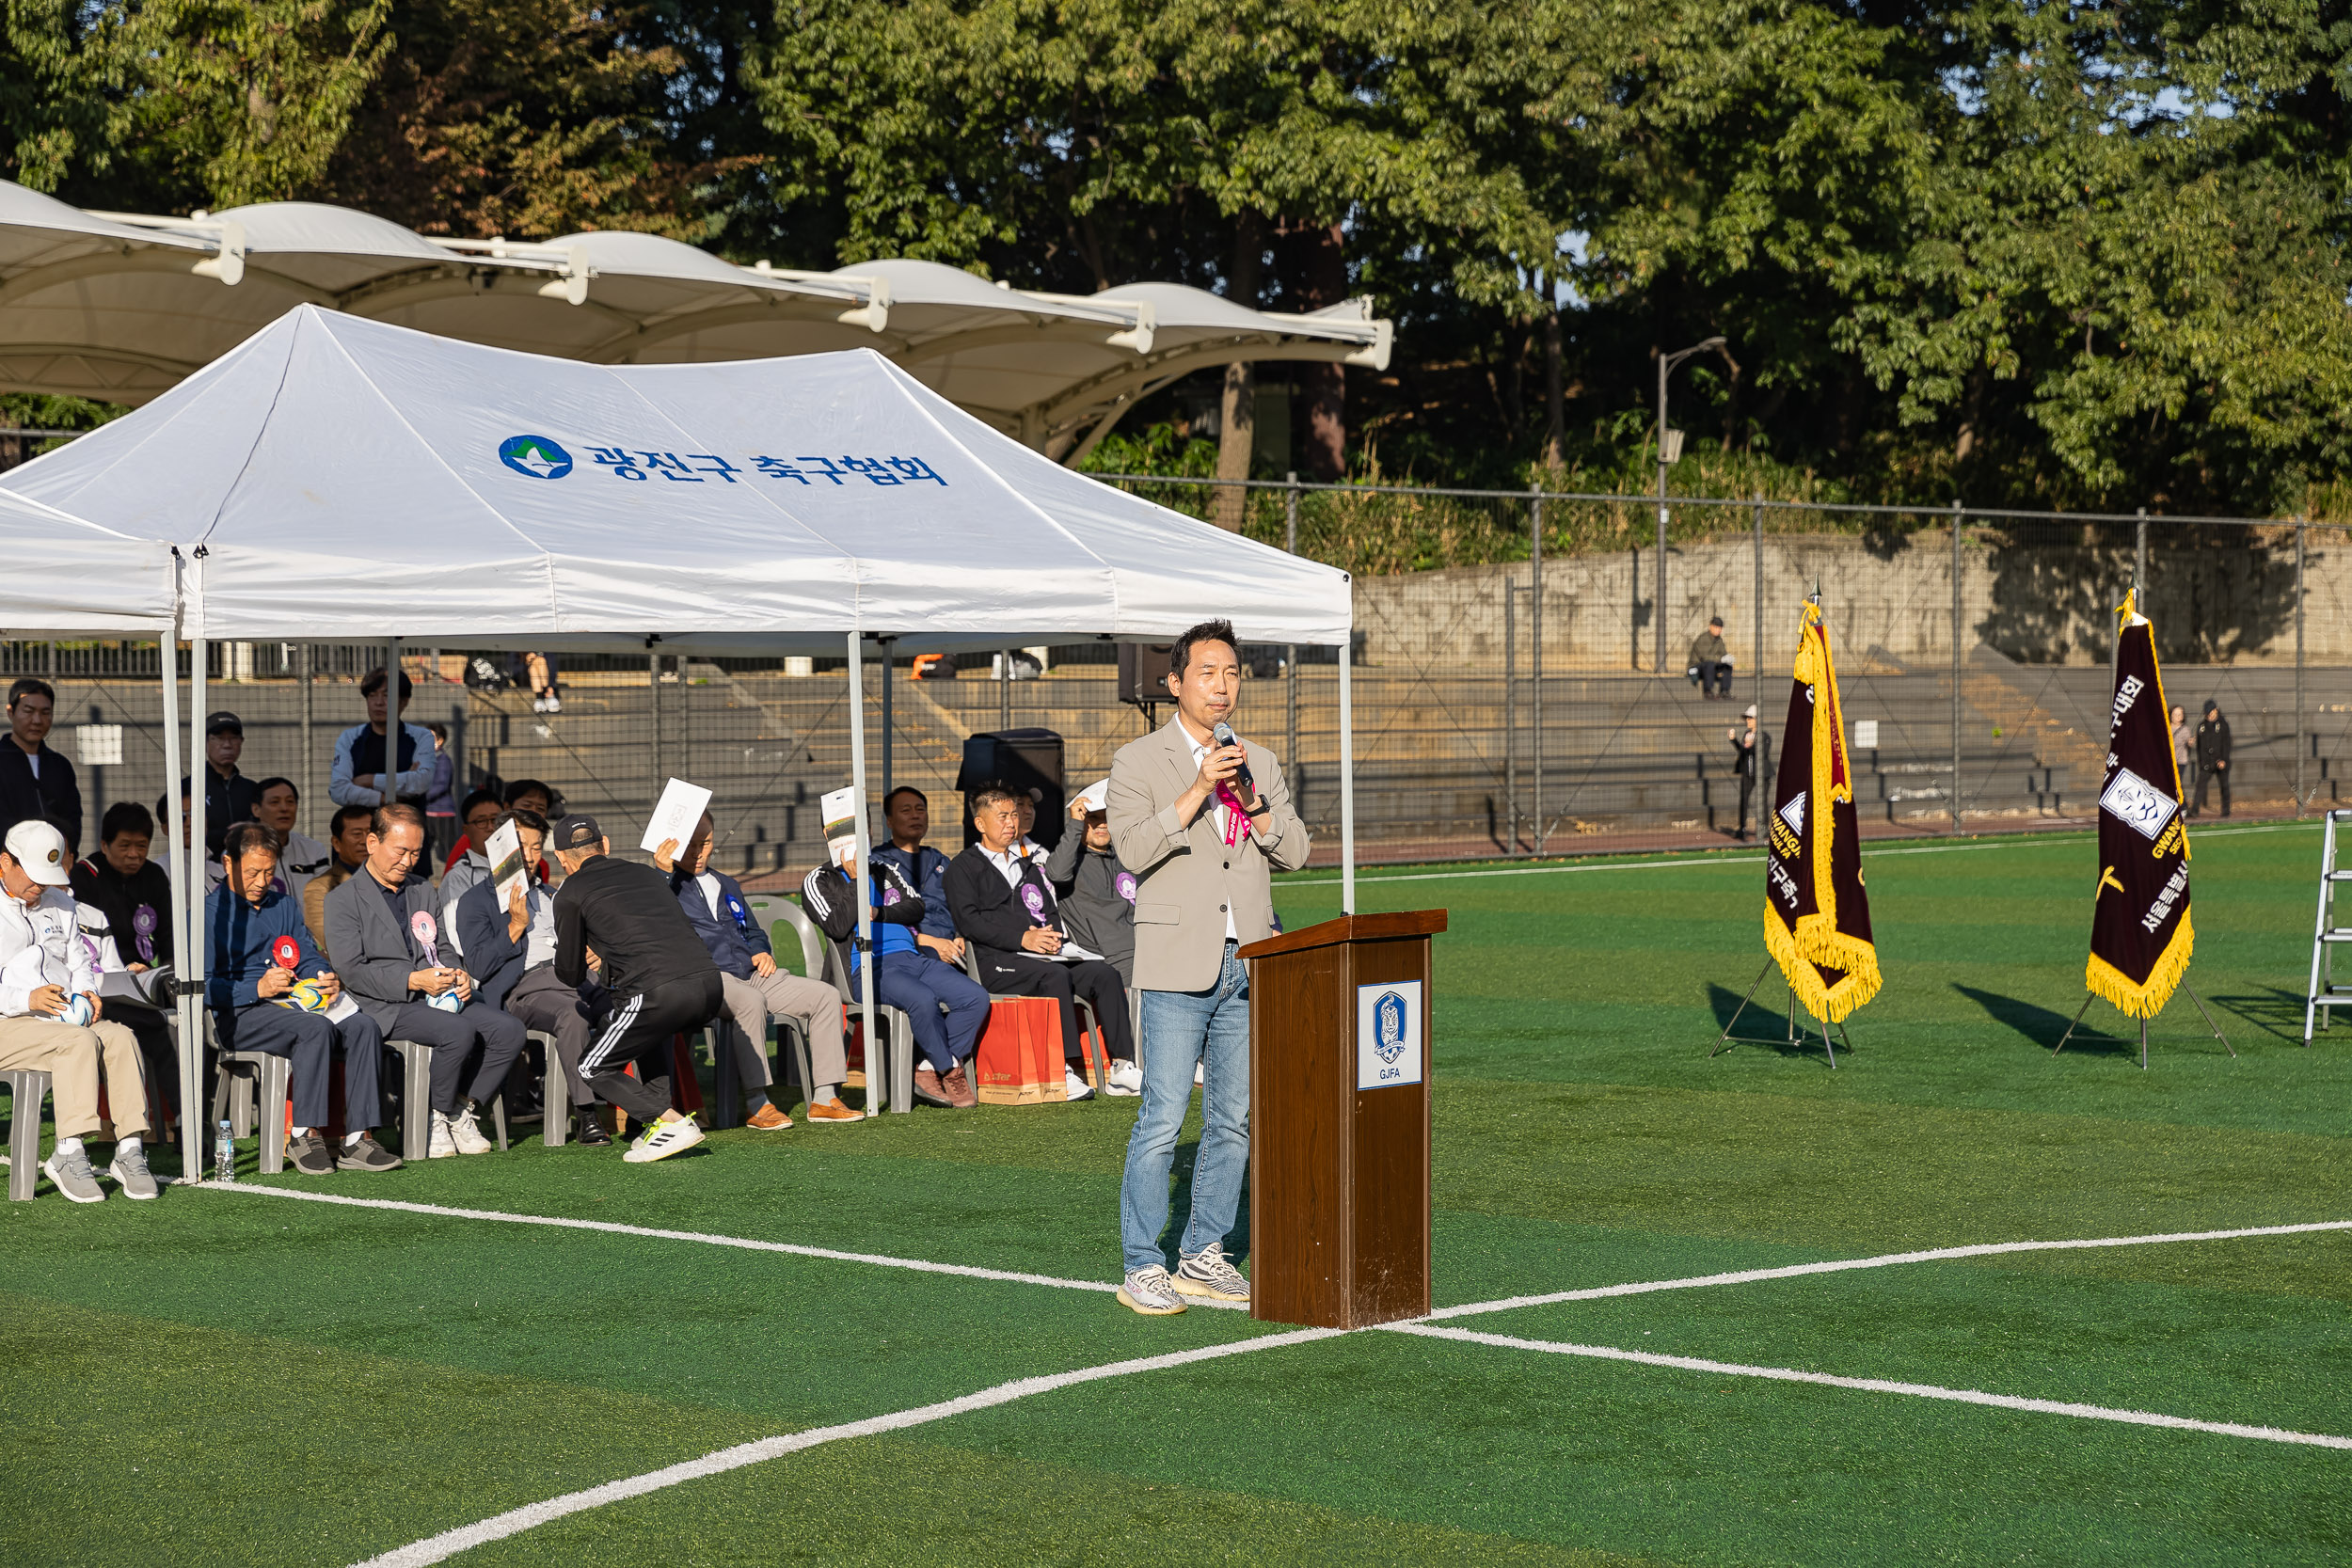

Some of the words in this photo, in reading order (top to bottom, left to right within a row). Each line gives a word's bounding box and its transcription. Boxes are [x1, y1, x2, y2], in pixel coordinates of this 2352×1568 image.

[582, 446, 743, 483] 광진구
[749, 454, 949, 487] 축구협회
[1379, 1068, 1401, 1080] GJFA
